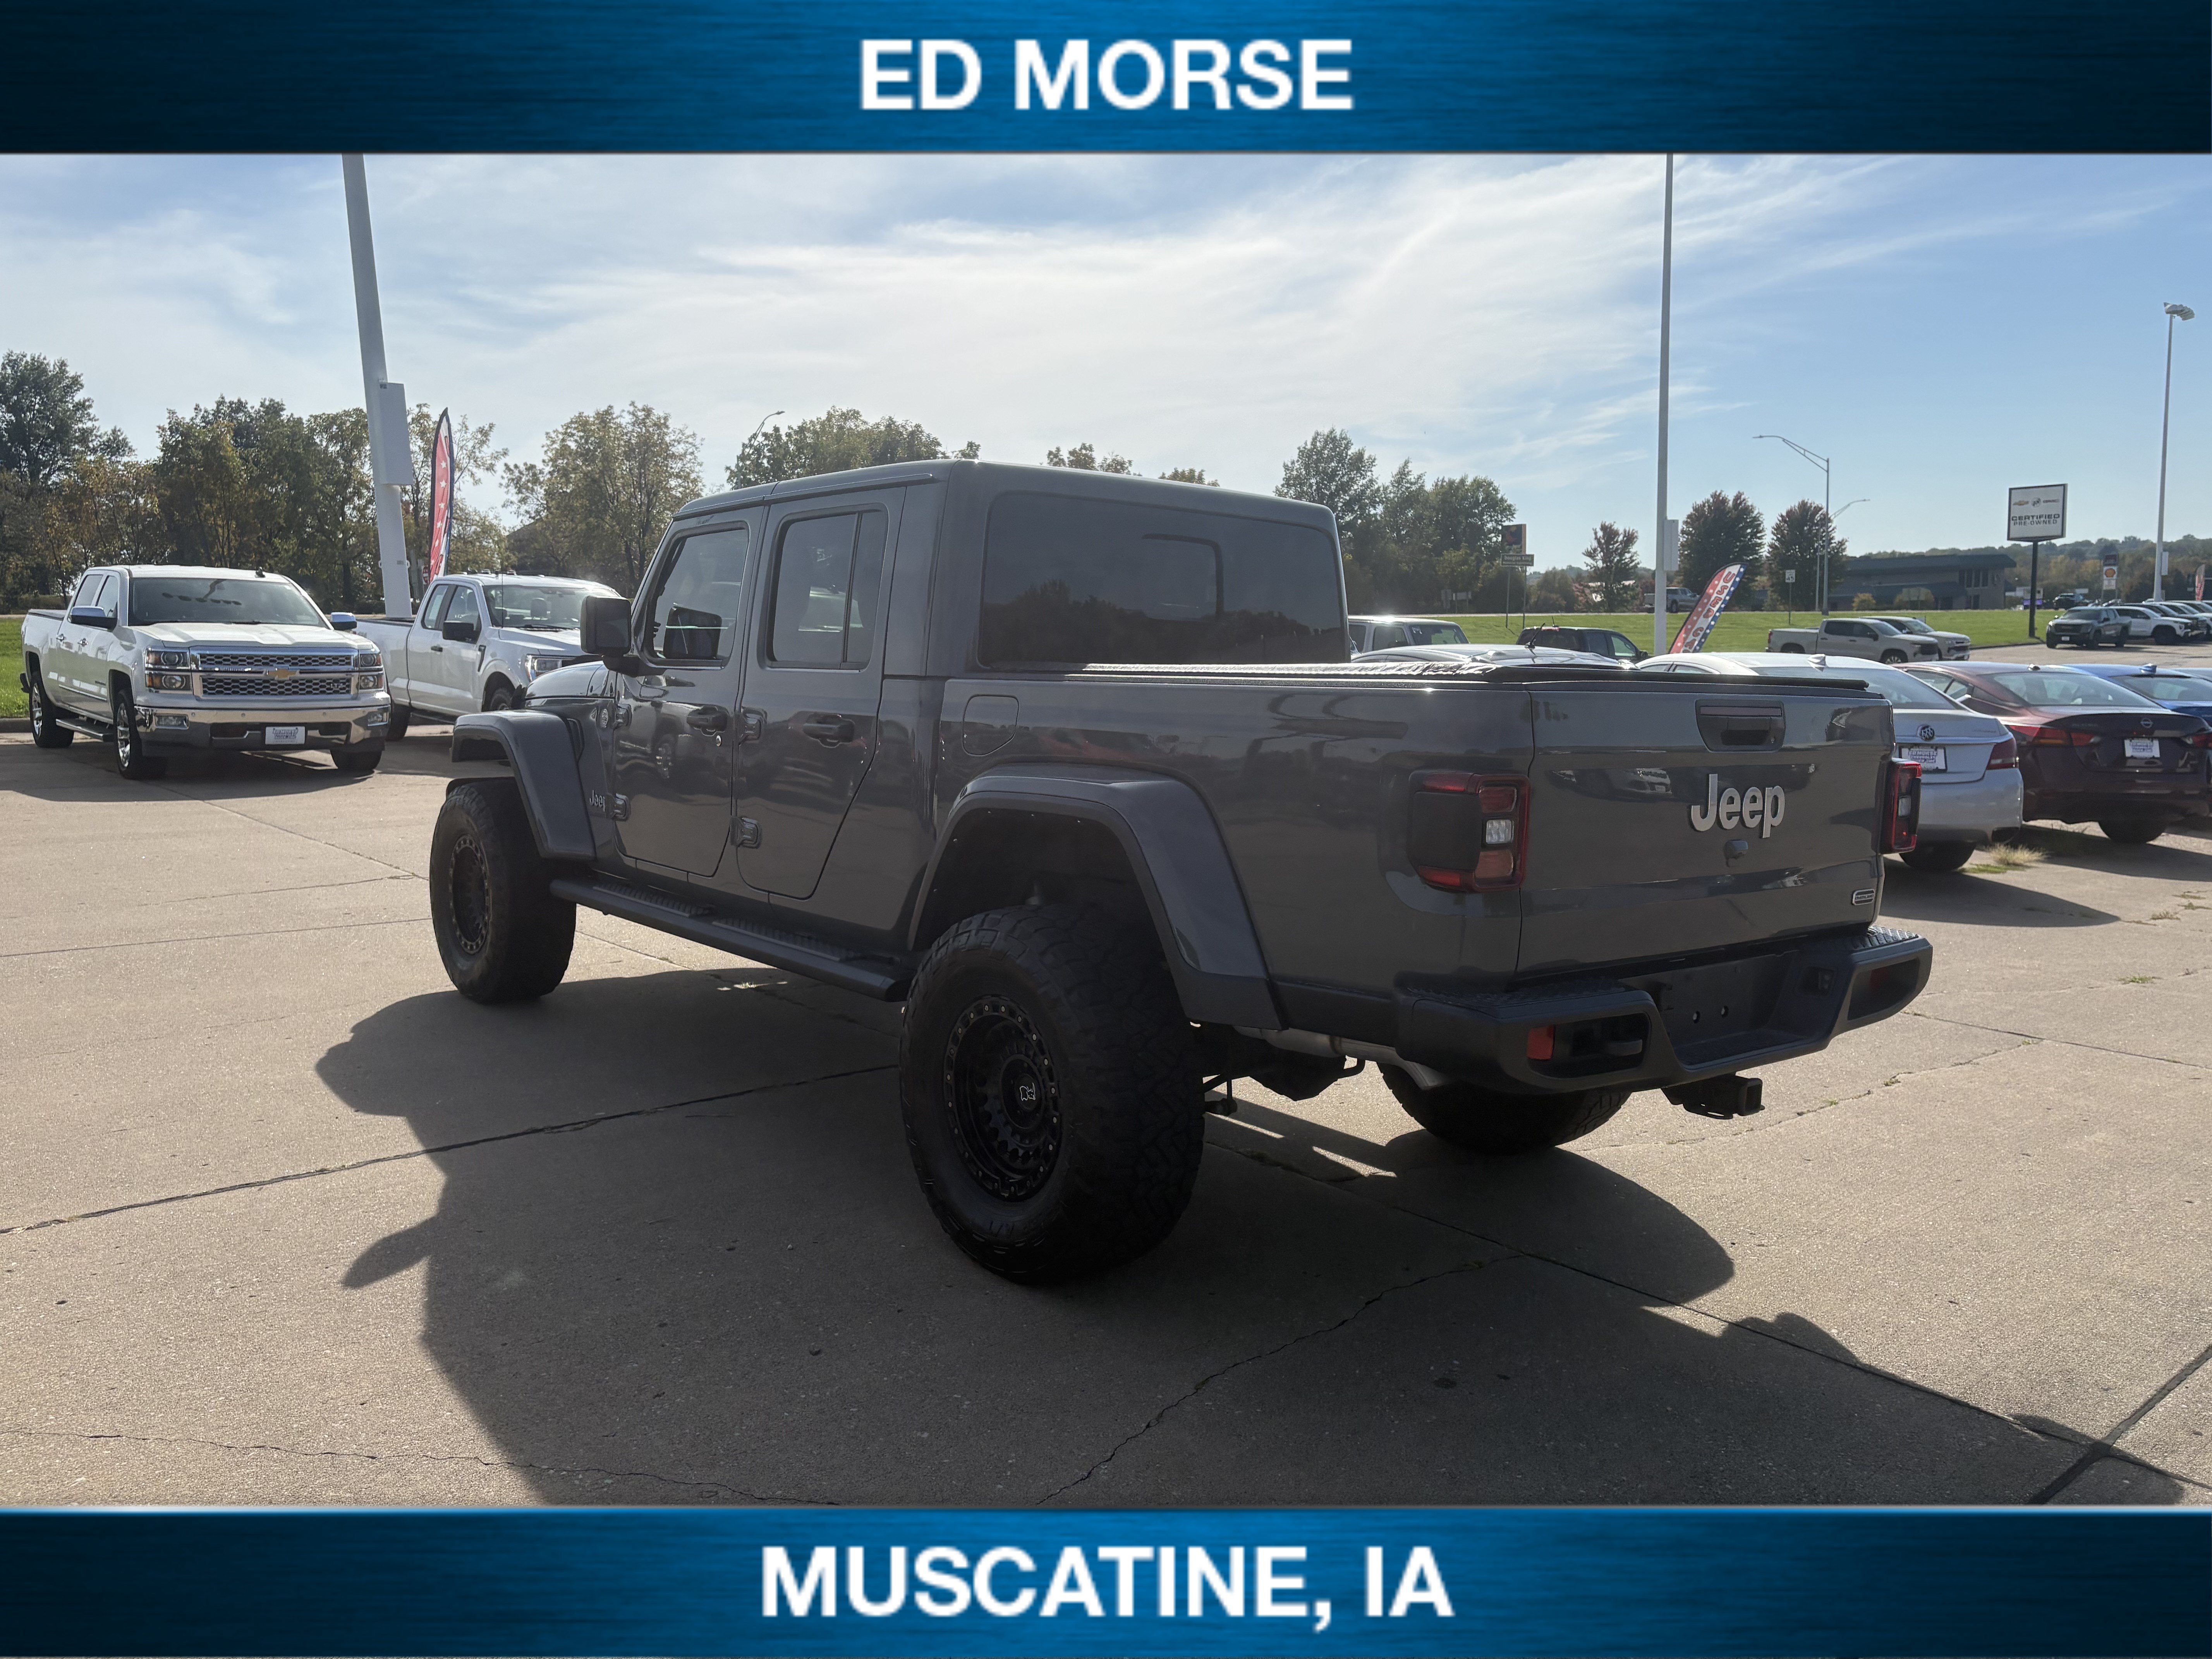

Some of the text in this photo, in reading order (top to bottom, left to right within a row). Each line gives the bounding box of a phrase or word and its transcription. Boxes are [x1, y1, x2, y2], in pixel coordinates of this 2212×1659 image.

[1703, 571, 1736, 618] USED
[589, 790, 605, 812] Jeep
[1690, 773, 1786, 838] Jeep
